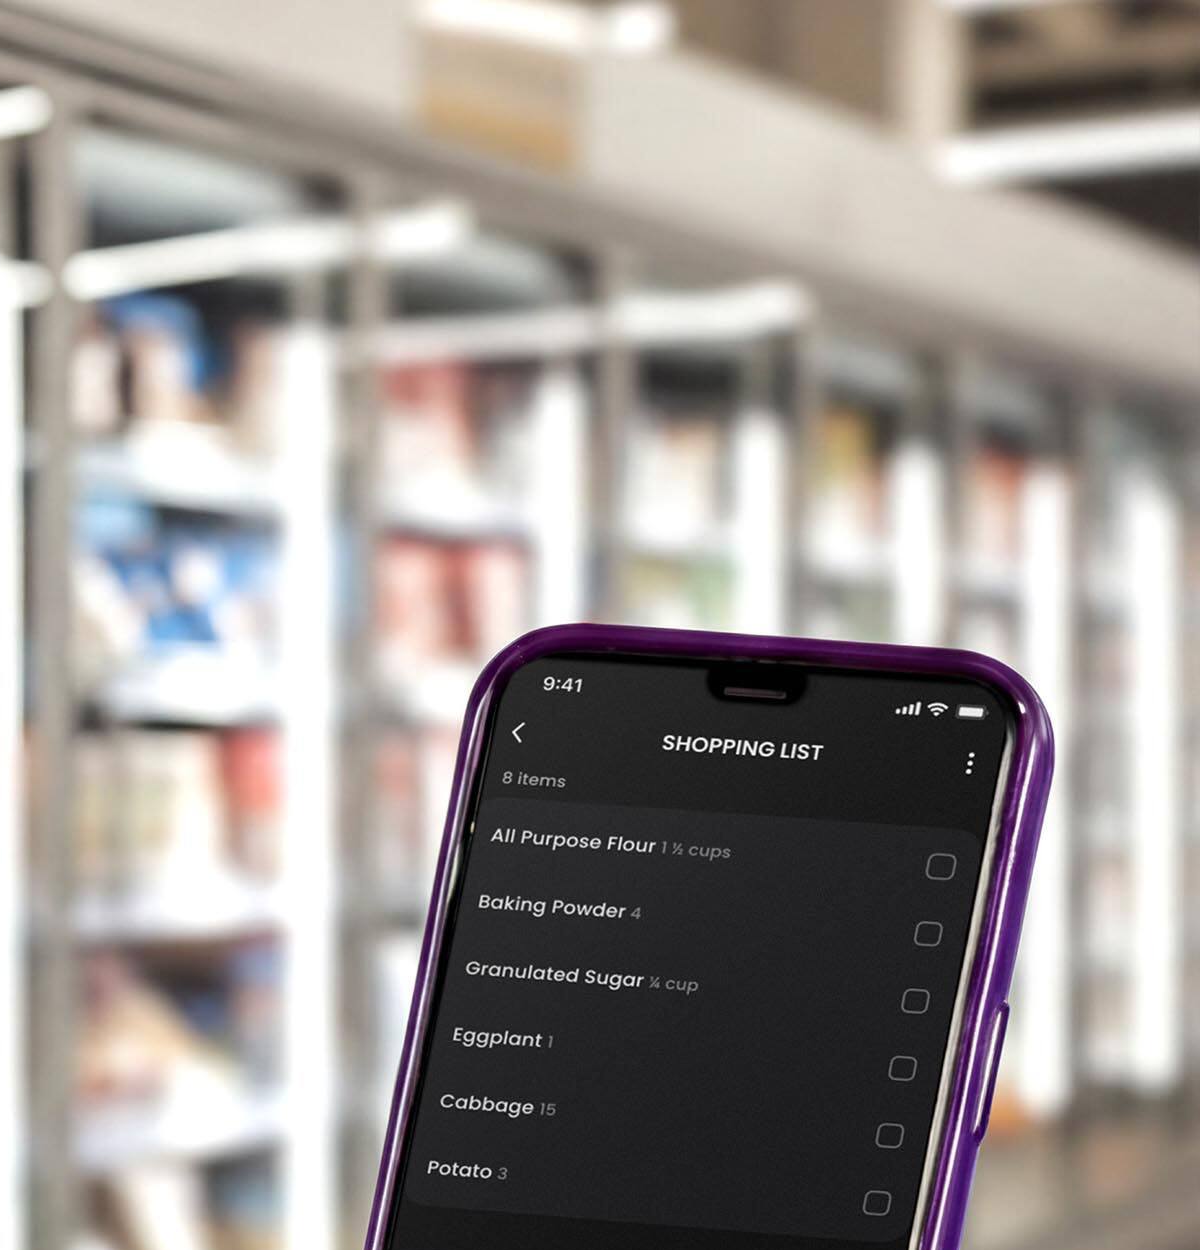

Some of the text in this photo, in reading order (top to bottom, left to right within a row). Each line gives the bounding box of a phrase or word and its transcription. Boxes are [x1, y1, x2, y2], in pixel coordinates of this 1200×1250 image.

[543, 676, 583, 693] 9:41
[662, 734, 824, 761] SHOPPING LIST
[502, 770, 567, 788] 8 items
[490, 828, 516, 844] All
[520, 830, 602, 851] Purpose
[606, 836, 657, 853] Flour
[688, 845, 732, 861] cups
[478, 895, 642, 919] Baking Powder 4
[465, 960, 580, 982] Granulated
[584, 969, 645, 991] Sugar
[665, 979, 699, 995] cup
[452, 1027, 554, 1049] Eggplant 1
[439, 1093, 557, 1118] Cabbage 15
[427, 1160, 508, 1181] Potato 3
